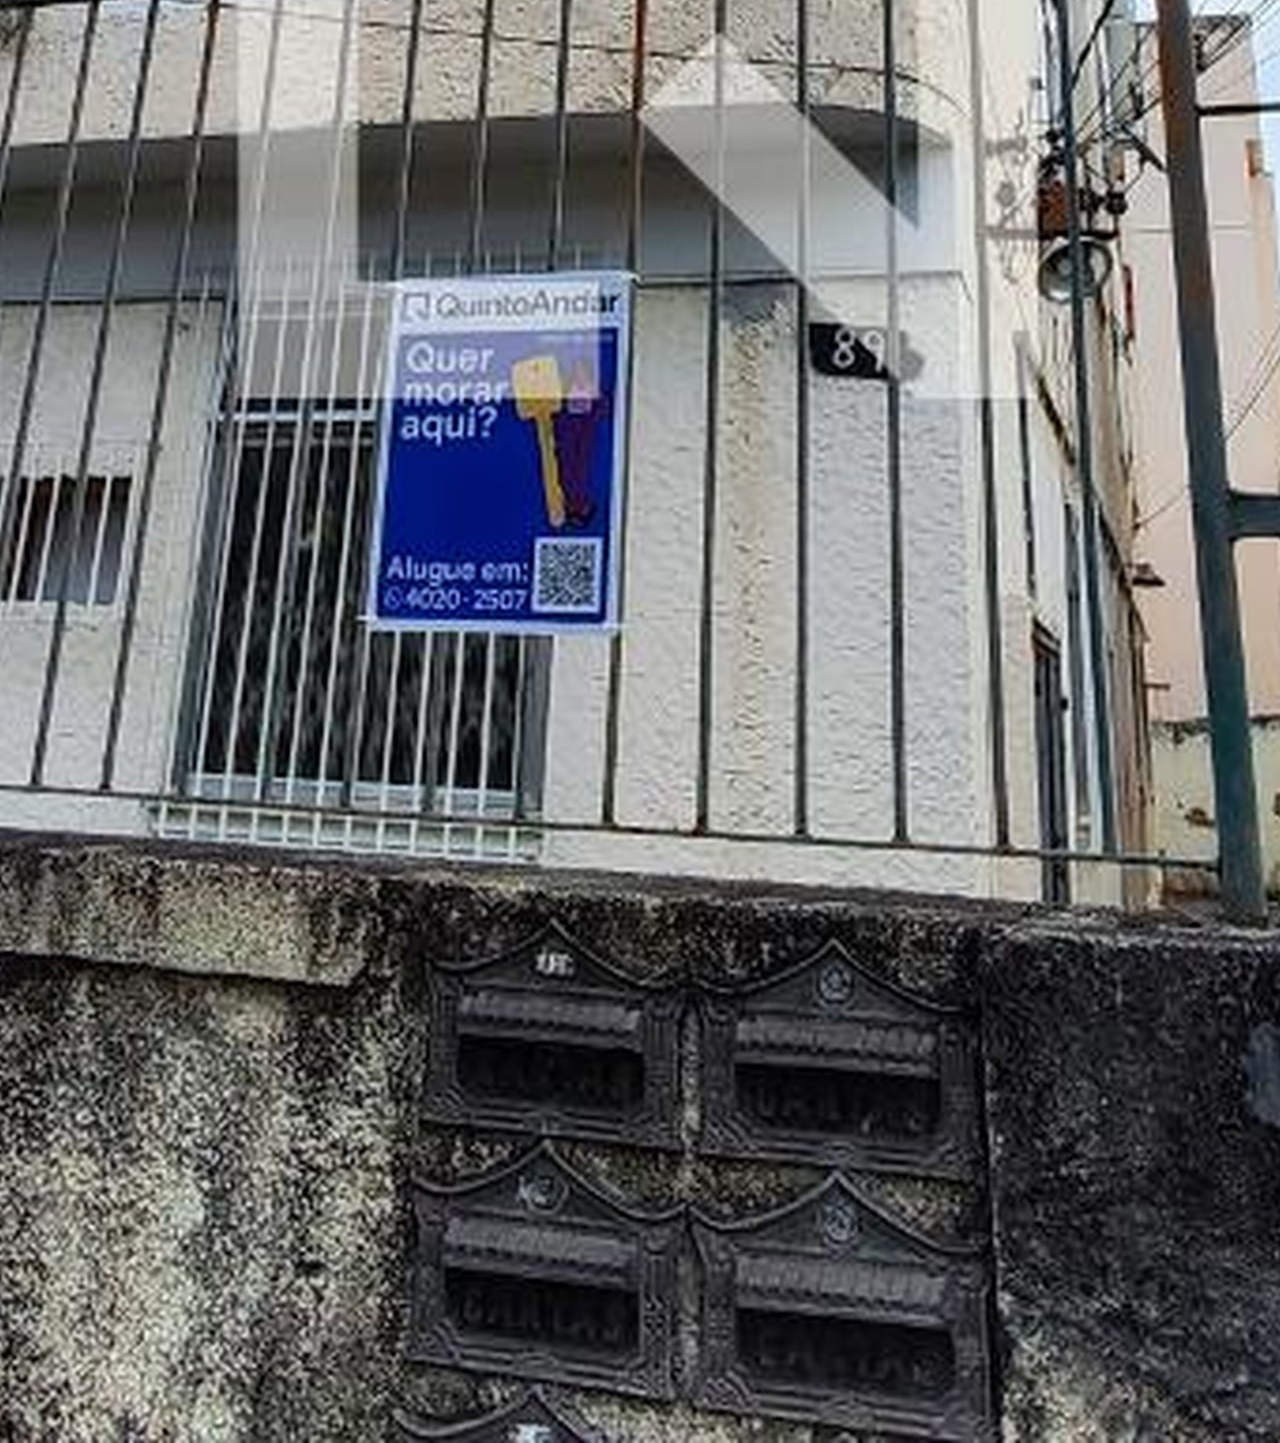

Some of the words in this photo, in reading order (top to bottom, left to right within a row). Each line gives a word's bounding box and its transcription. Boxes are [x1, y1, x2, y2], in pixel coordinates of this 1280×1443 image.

[436, 290, 620, 318] QuintoAndar
[406, 341, 494, 373] Quer
[832, 326, 885, 372] 89
[402, 378, 509, 406] morar
[401, 405, 498, 446] aqui?
[387, 555, 476, 587] Alugue
[481, 562, 528, 583] em:
